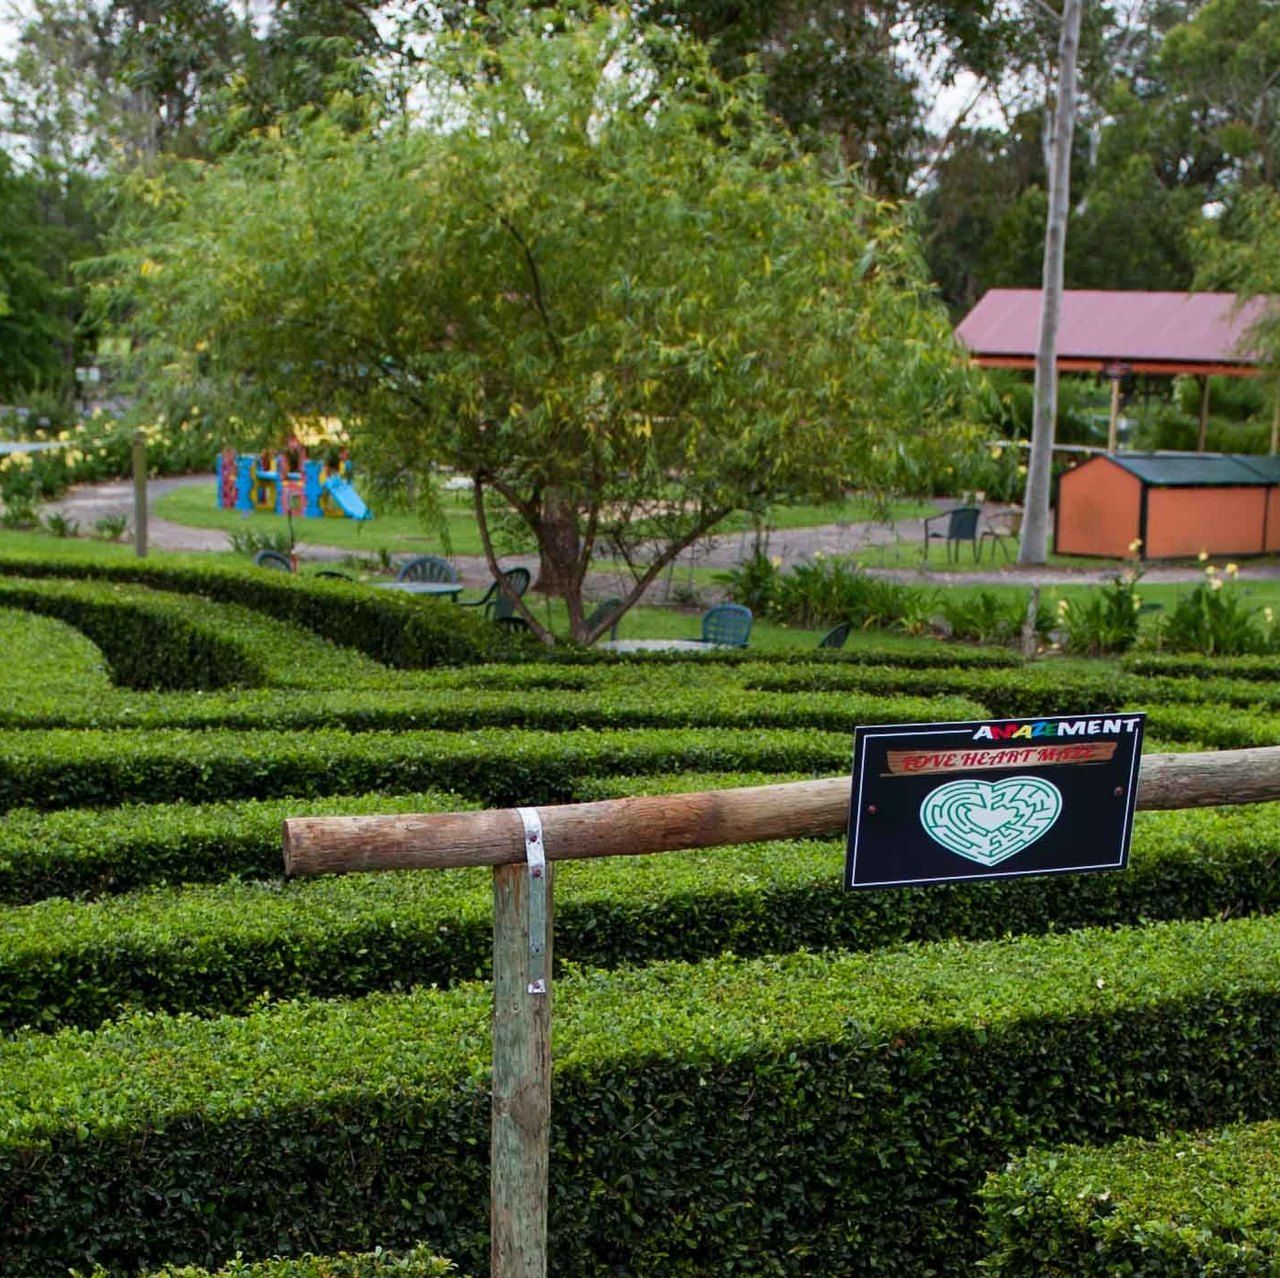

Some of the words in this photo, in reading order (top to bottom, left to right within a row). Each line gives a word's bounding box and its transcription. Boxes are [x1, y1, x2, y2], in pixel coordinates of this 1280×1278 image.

[973, 718, 1140, 740] AMAZEMENT
[902, 753, 957, 771] LOVE
[961, 749, 1036, 766] HEART
[1037, 743, 1096, 762] MAZE
